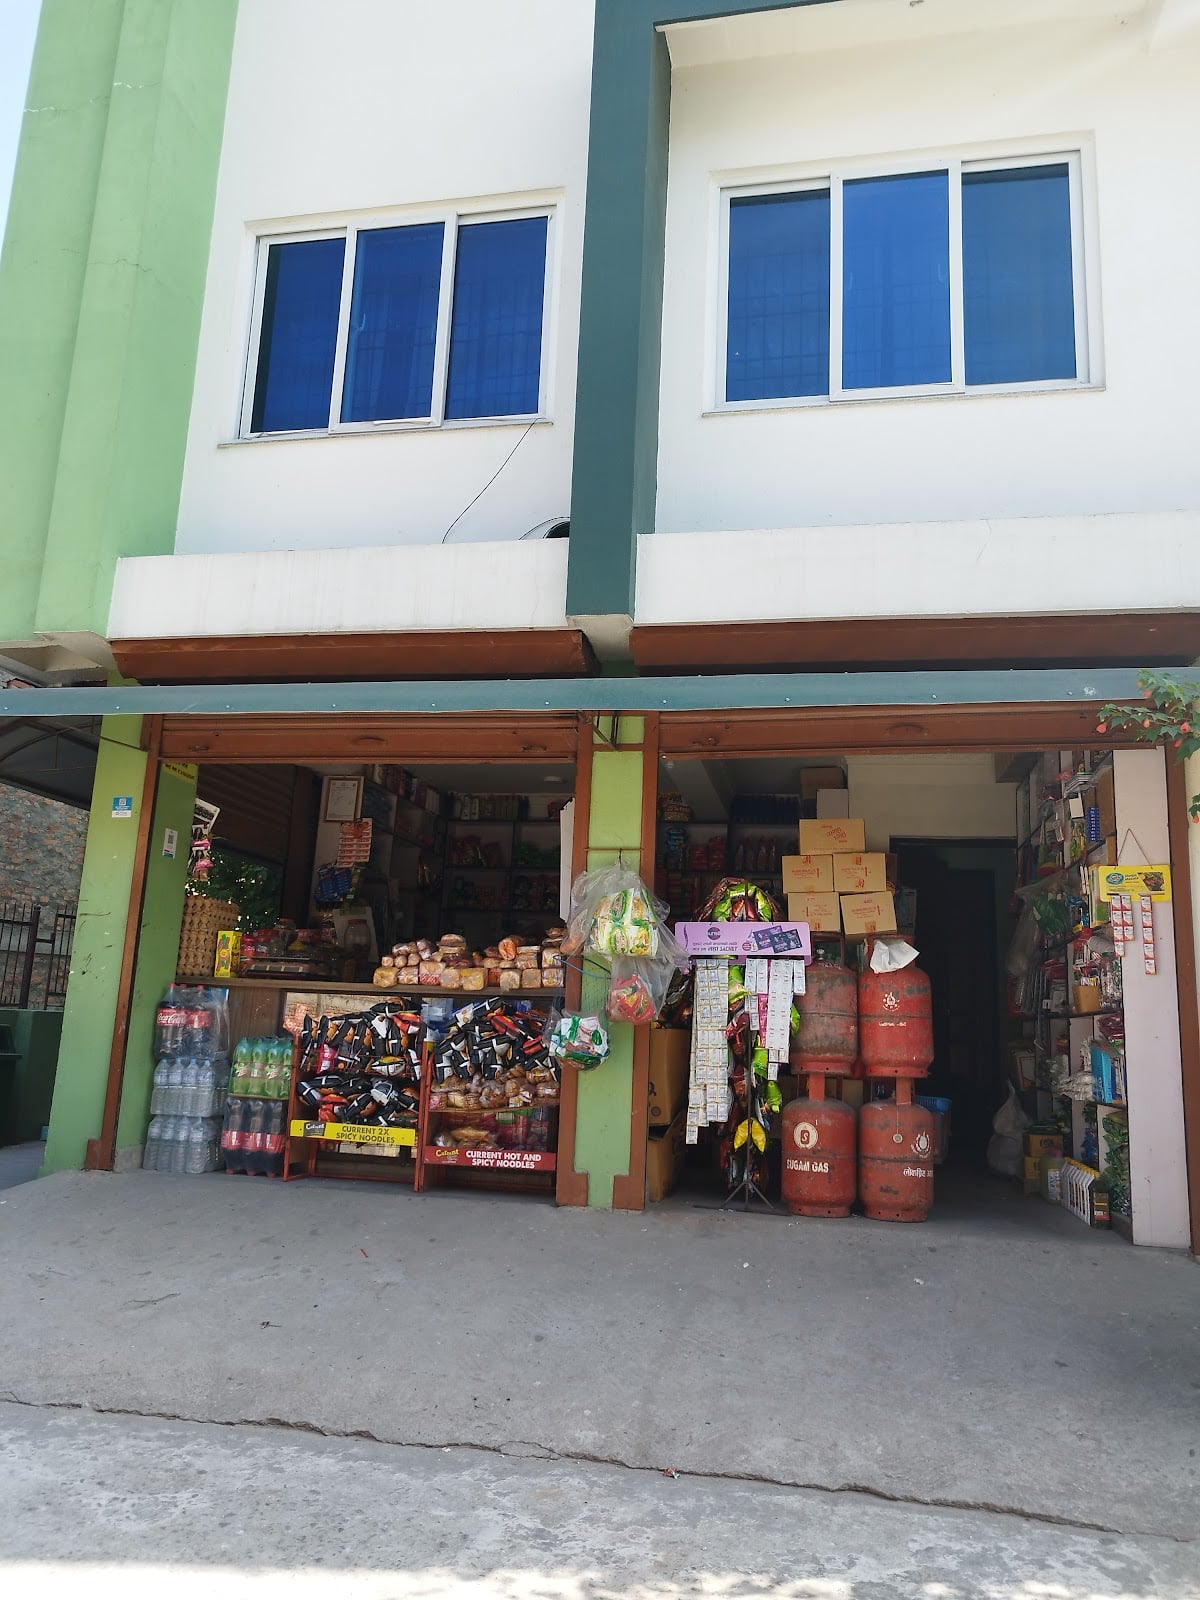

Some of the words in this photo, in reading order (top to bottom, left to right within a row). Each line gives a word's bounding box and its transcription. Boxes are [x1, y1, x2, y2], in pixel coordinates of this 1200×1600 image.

[342, 1125, 375, 1135] CURRENT
[378, 1128, 390, 1136] 2X
[336, 1132, 357, 1140] SPICY
[360, 1134, 395, 1144] NOODLES
[466, 1150, 502, 1159] CURRENT
[504, 1152, 521, 1160] HOT
[523, 1153, 541, 1162] AND
[472, 1158, 495, 1167] SPICY
[496, 1159, 535, 1169] NOODLES
[786, 1159, 810, 1171] SUGAM
[812, 1162, 829, 1173] GAS
